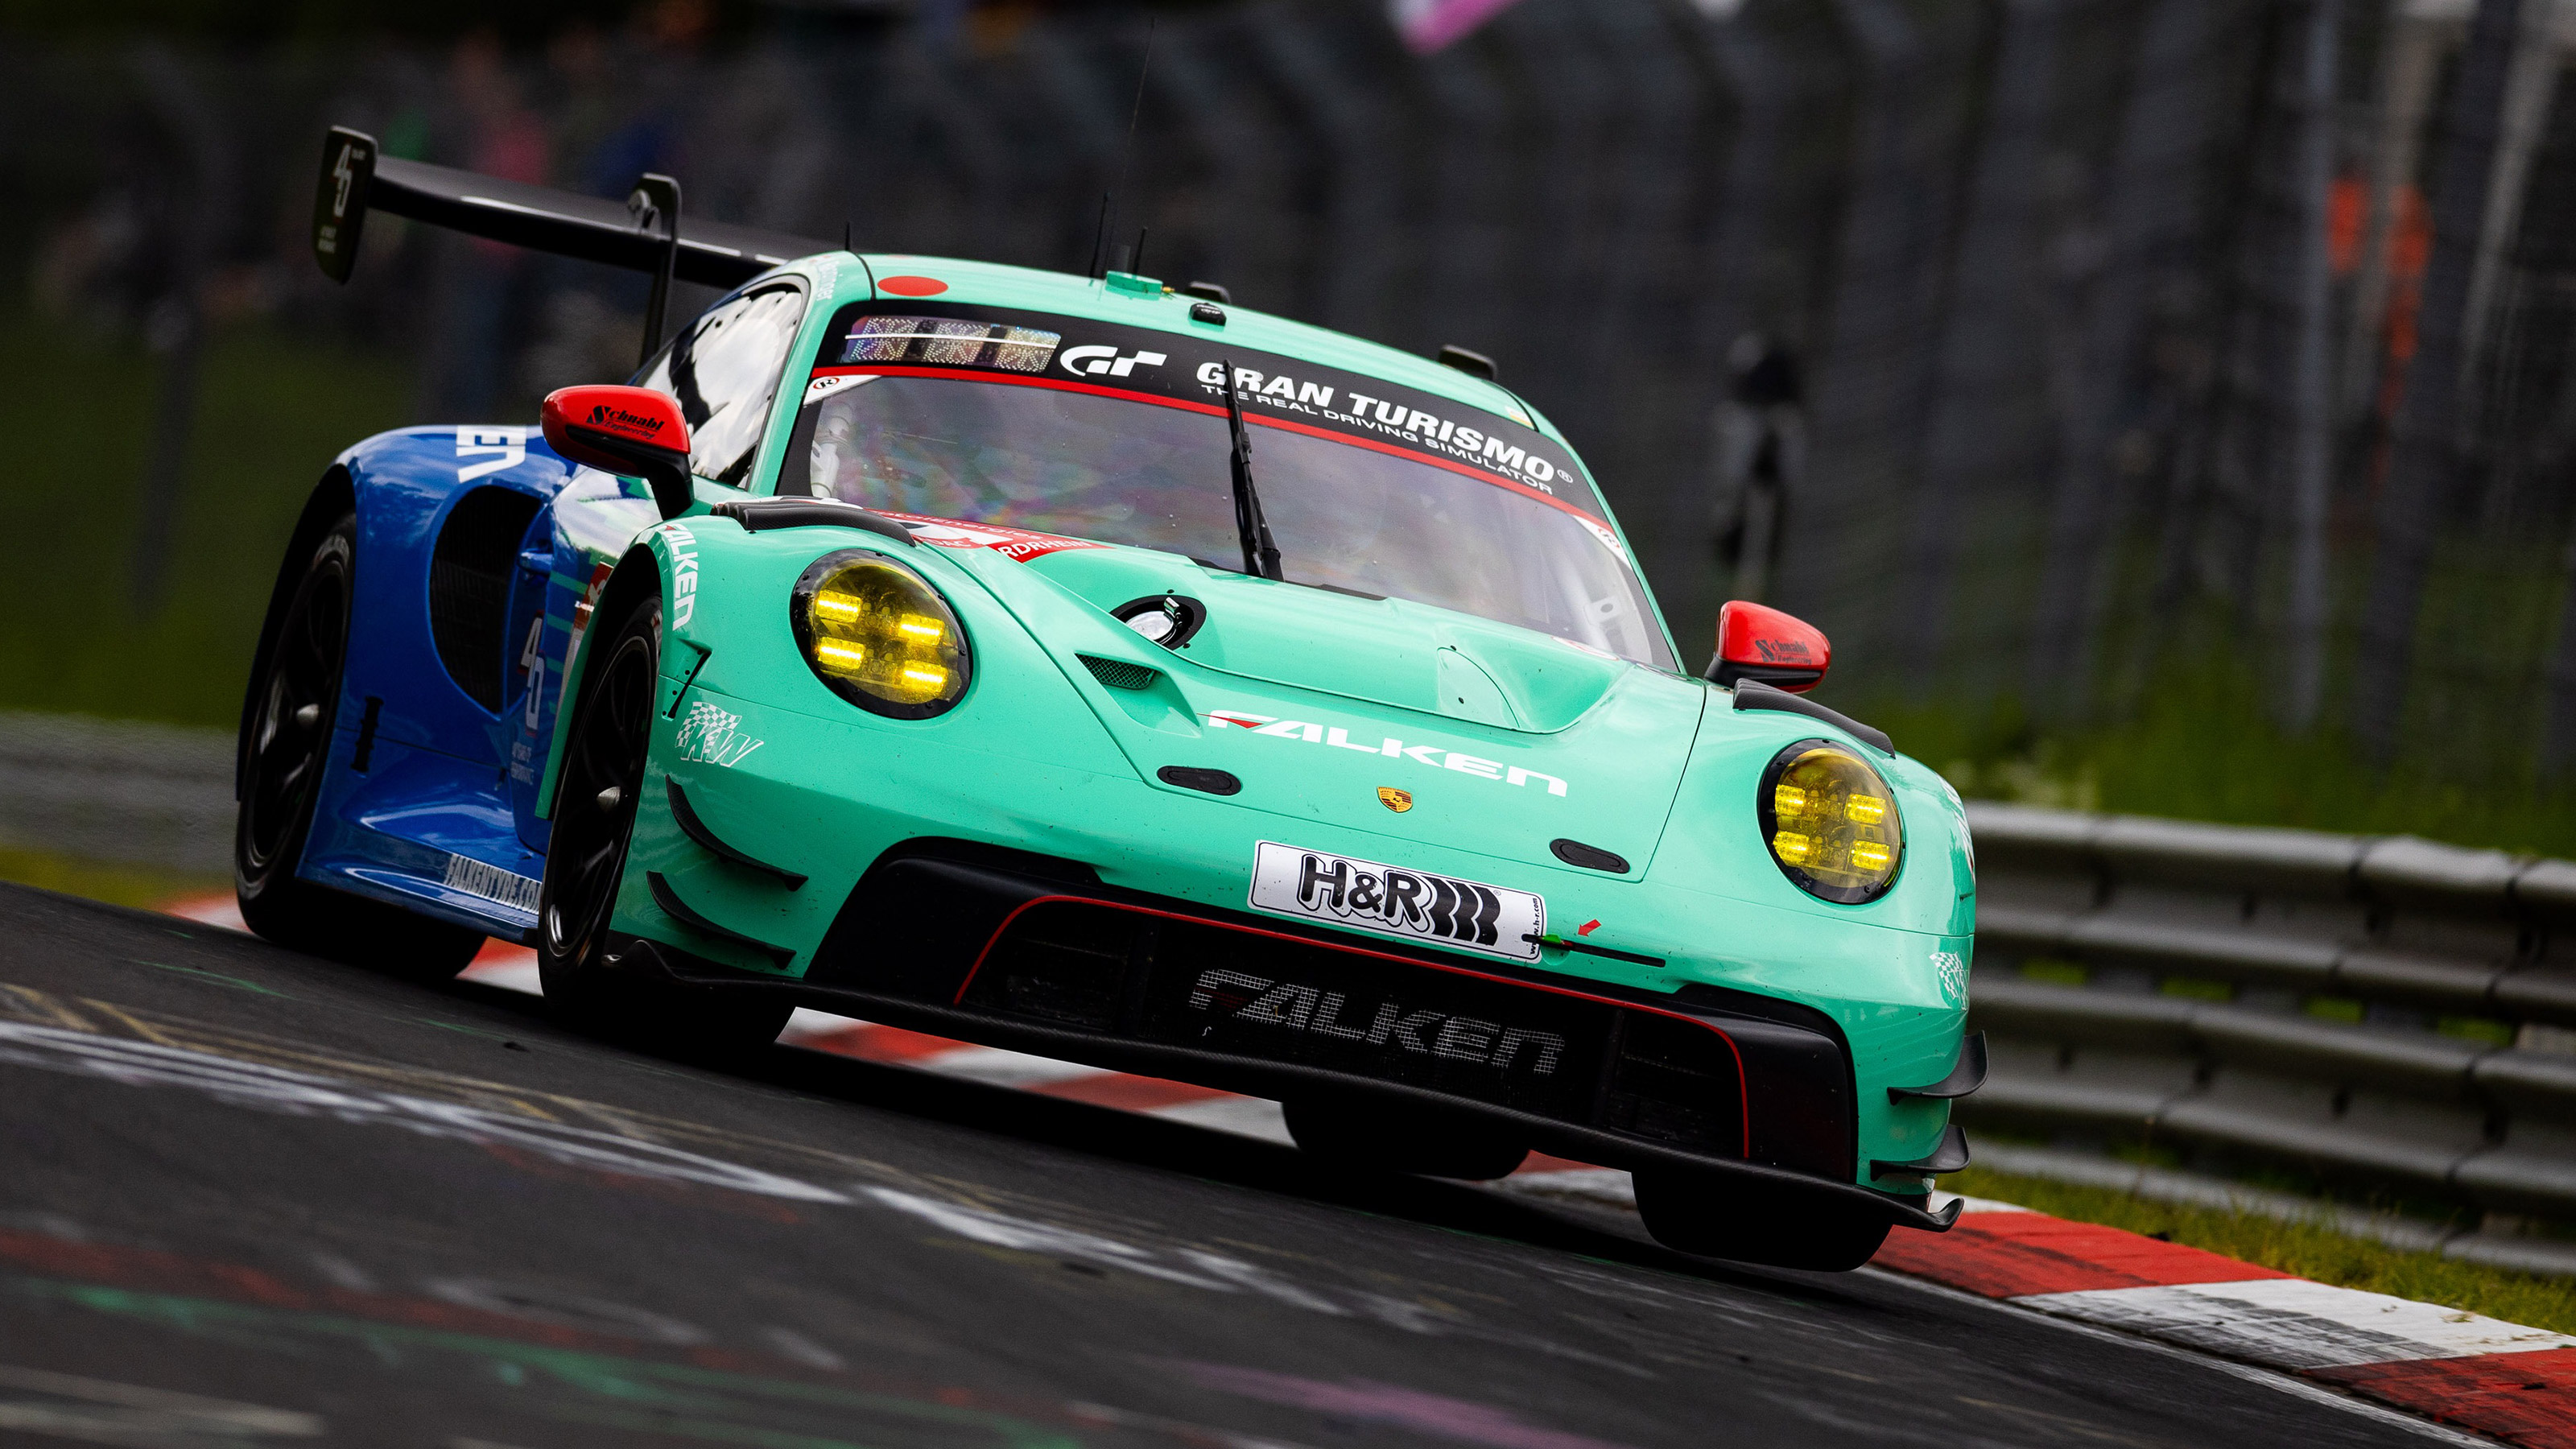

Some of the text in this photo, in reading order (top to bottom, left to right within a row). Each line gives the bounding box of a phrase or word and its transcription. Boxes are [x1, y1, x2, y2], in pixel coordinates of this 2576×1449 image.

[1059, 345, 1167, 377] GT
[1196, 362, 1335, 408] GRAN
[1201, 384, 1553, 495] THE REAL DRIVING SIMULATOR
[1197, 709, 1568, 798] FALKEN
[1297, 854, 1430, 933] H&R
[1530, 898, 1540, 955] ww.h-r.com
[1189, 968, 1566, 1075] FALKEN
